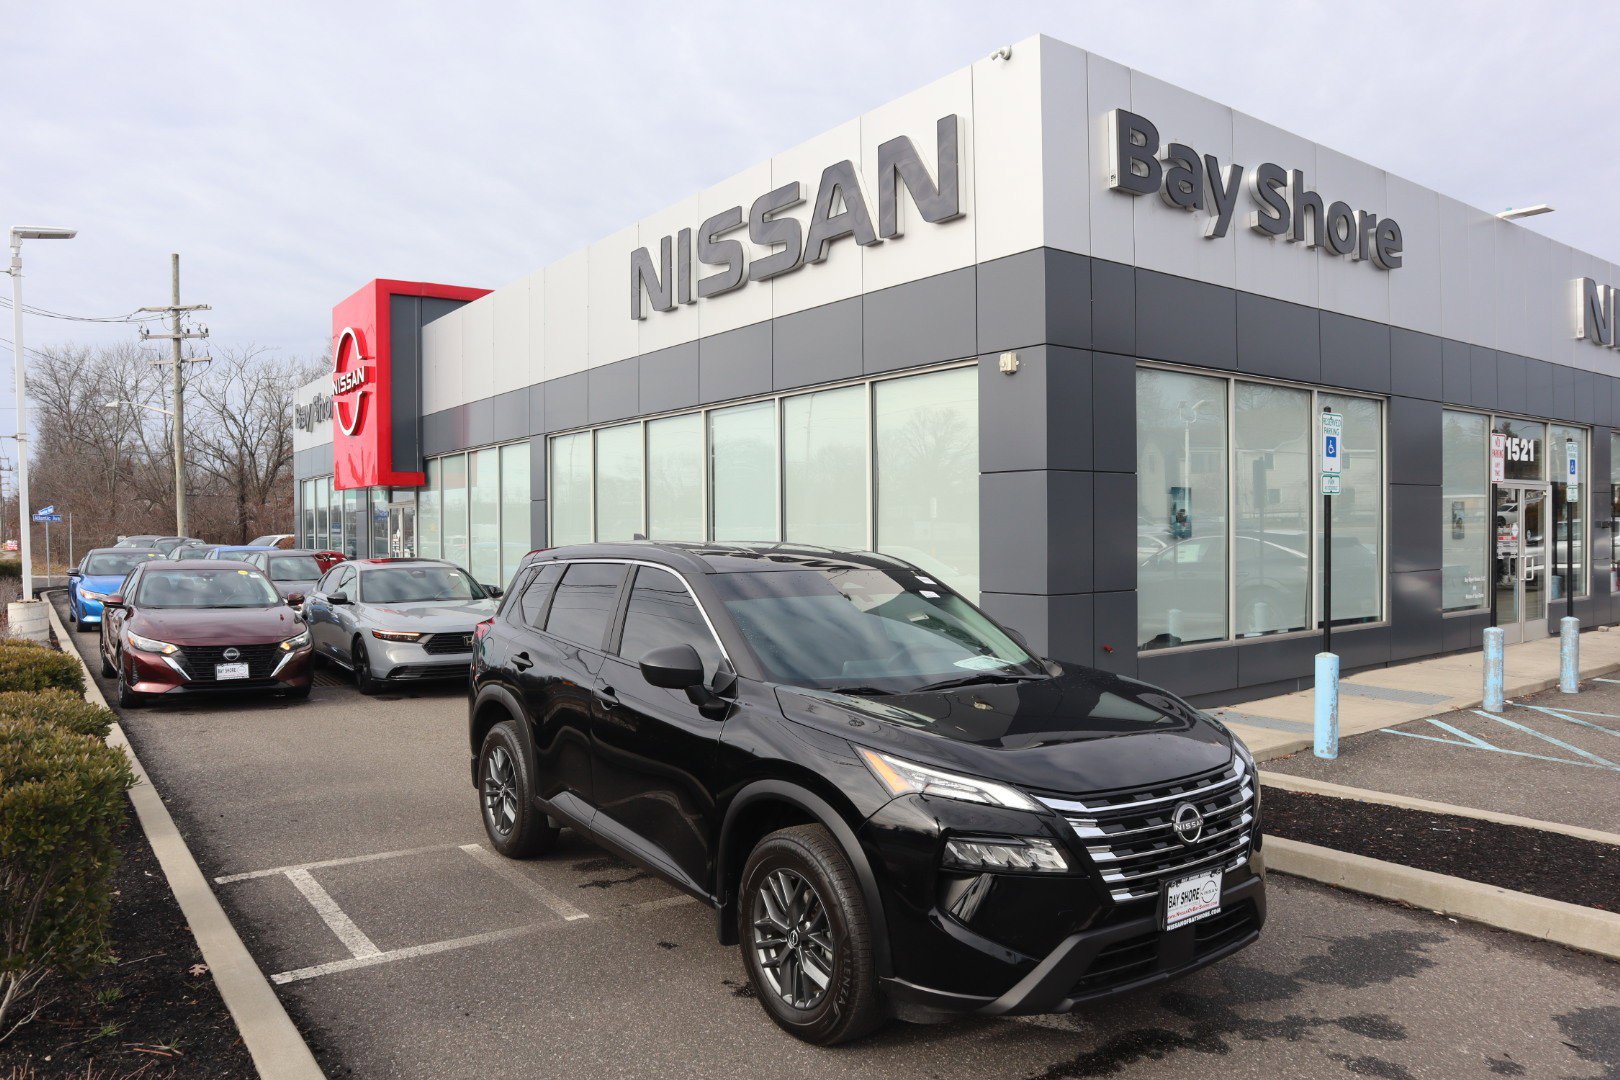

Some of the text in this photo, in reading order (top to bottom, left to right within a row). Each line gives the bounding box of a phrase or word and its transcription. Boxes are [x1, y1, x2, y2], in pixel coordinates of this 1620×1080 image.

[1109, 108, 1403, 270] Bay Shore
[631, 113, 966, 321] NISSAN
[332, 366, 365, 395] NISSAN
[294, 404, 314, 433] Bay
[1324, 427, 1340, 436] PARKING
[1506, 436, 1535, 461] 1521
[1175, 817, 1204, 831] NISSAN
[1168, 893, 1180, 909] BAY
[1181, 887, 1200, 905] SHORE
[838, 946, 851, 1005] ALENZA
